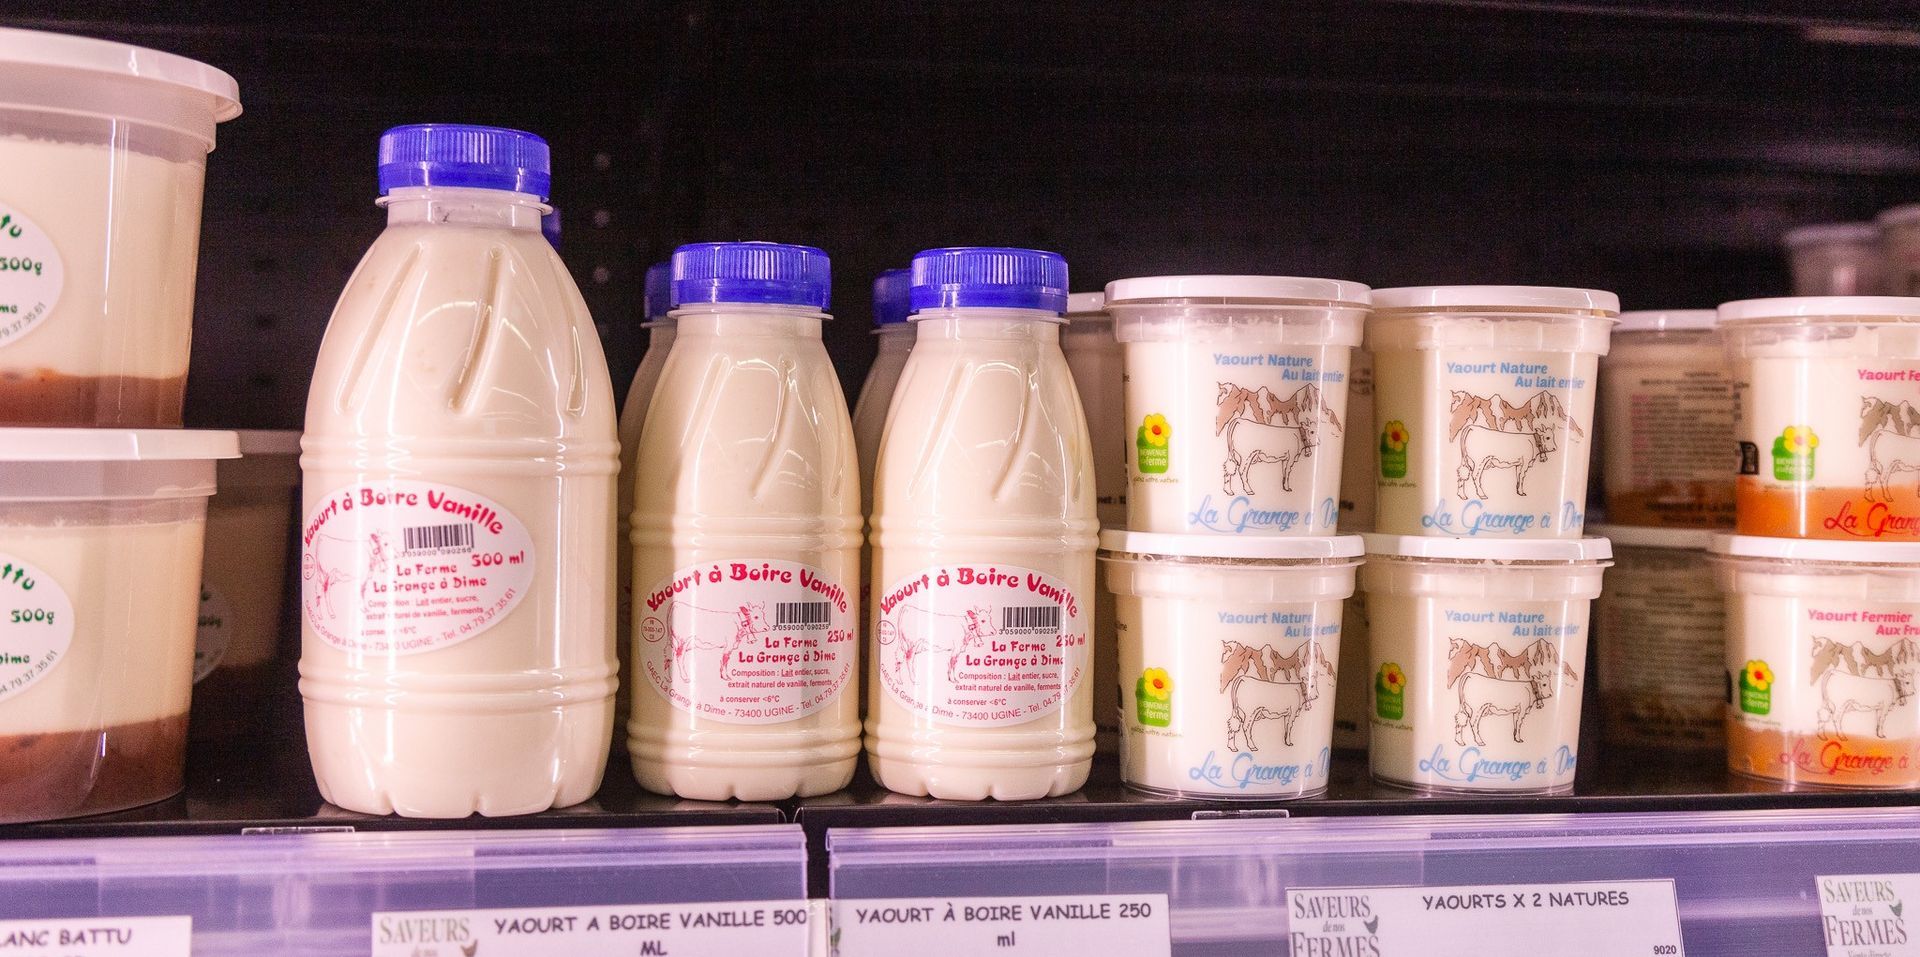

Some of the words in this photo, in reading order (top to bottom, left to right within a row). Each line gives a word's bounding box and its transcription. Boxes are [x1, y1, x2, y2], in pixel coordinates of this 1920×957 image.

[1213, 353, 1264, 366] Yaourt
[1267, 354, 1313, 367] Nature
[1447, 362, 1497, 374] Yaourt
[1500, 362, 1548, 374] Nature
[1281, 368, 1299, 381] Au
[1515, 376, 1532, 388] Au
[1535, 376, 1556, 388] lait
[1857, 368, 1905, 381] Yaourt
[304, 499, 338, 547] Yaourt
[342, 492, 354, 511] à
[427, 490, 503, 535] Vanille
[1188, 494, 1218, 528] La
[1227, 495, 1300, 533] Grange
[1421, 498, 1453, 530] La
[1461, 500, 1535, 535] Grange
[1824, 500, 1857, 531] La
[471, 552, 503, 567] 500
[508, 550, 524, 565] ml
[396, 565, 411, 576] La
[416, 563, 457, 575] Ferme
[373, 582, 387, 593] La
[440, 578, 448, 589] à
[453, 576, 487, 589] Dime
[646, 569, 702, 612] Yaourt
[708, 565, 723, 583] à
[729, 562, 793, 584] Boire
[799, 568, 848, 614] Vanille
[880, 574, 930, 615] Yaourt
[936, 569, 950, 587] à
[957, 567, 1019, 588] Boire
[1027, 572, 1078, 618] Vanille
[11, 608, 55, 625] 500g
[1218, 611, 1267, 624] Yaourt
[1271, 612, 1314, 624] Natur
[1445, 610, 1495, 623] Yaourt
[1498, 611, 1545, 624] Nature
[1808, 608, 1858, 622] Yaourt
[1861, 611, 1913, 623] Fermier
[827, 630, 845, 643] 250
[1284, 625, 1300, 637] Au
[1512, 625, 1530, 637] Au
[1532, 625, 1552, 637] lait
[1876, 624, 1901, 636] Aux
[765, 636, 780, 648] La
[783, 636, 818, 648] Ferme
[991, 641, 1006, 652] La
[1010, 641, 1046, 652] Ferme
[738, 651, 754, 663] La
[756, 651, 801, 666] Grange
[803, 650, 810, 662] à
[813, 650, 836, 662] Dime
[966, 655, 981, 666] La
[983, 655, 1028, 669] Grange
[1030, 654, 1037, 666] à
[731, 668, 776, 677] Composition
[781, 668, 794, 678] Lait
[958, 671, 1002, 680] Composition
[1008, 671, 1020, 681] Lait
[751, 680, 775, 688] naturel
[776, 680, 785, 688] de
[1013, 683, 1036, 692] vanille,
[1037, 683, 1061, 691] ferments
[660, 680, 669, 692] La
[669, 688, 694, 706] Grang
[703, 703, 726, 715] Dime
[735, 708, 762, 718] 73400
[764, 705, 795, 717] UGINE
[726, 695, 761, 703] conserver
[953, 698, 987, 706] conserver
[931, 705, 954, 718] Dime
[962, 711, 989, 720] 73400
[991, 708, 1022, 720] UGINE
[1027, 703, 1042, 714] Tel.
[1419, 744, 1450, 776] La
[1458, 746, 1532, 782] Grange
[1820, 741, 1893, 775] Grange
[1189, 750, 1221, 782] La
[1232, 752, 1300, 788] Grange
[1824, 880, 1895, 903] SAVEURS
[1294, 893, 1371, 919] SAVEURS
[1423, 895, 1507, 910] YAOURTS
[1513, 894, 1525, 908] X
[1533, 894, 1542, 908] 2
[1550, 891, 1629, 907] NATURES
[856, 907, 934, 924] YAOURT
[943, 902, 956, 922] À
[964, 905, 1022, 922] BOIRE
[1031, 903, 1111, 920] VANILLE
[1119, 902, 1152, 918] 250
[379, 916, 470, 943] SAVEURS
[495, 917, 577, 935] YAOURT
[586, 917, 600, 931] A
[609, 913, 671, 931] BOIRE
[680, 910, 766, 928] VANILLE
[773, 909, 807, 925] 500
[1322, 920, 1332, 933] de
[59, 928, 132, 945] BATTU
[996, 930, 1016, 947] ml
[1824, 915, 1907, 946] FERMES
[640, 941, 668, 957] ML
[1291, 932, 1380, 957] FERMES
[1653, 944, 1677, 955] 9020
